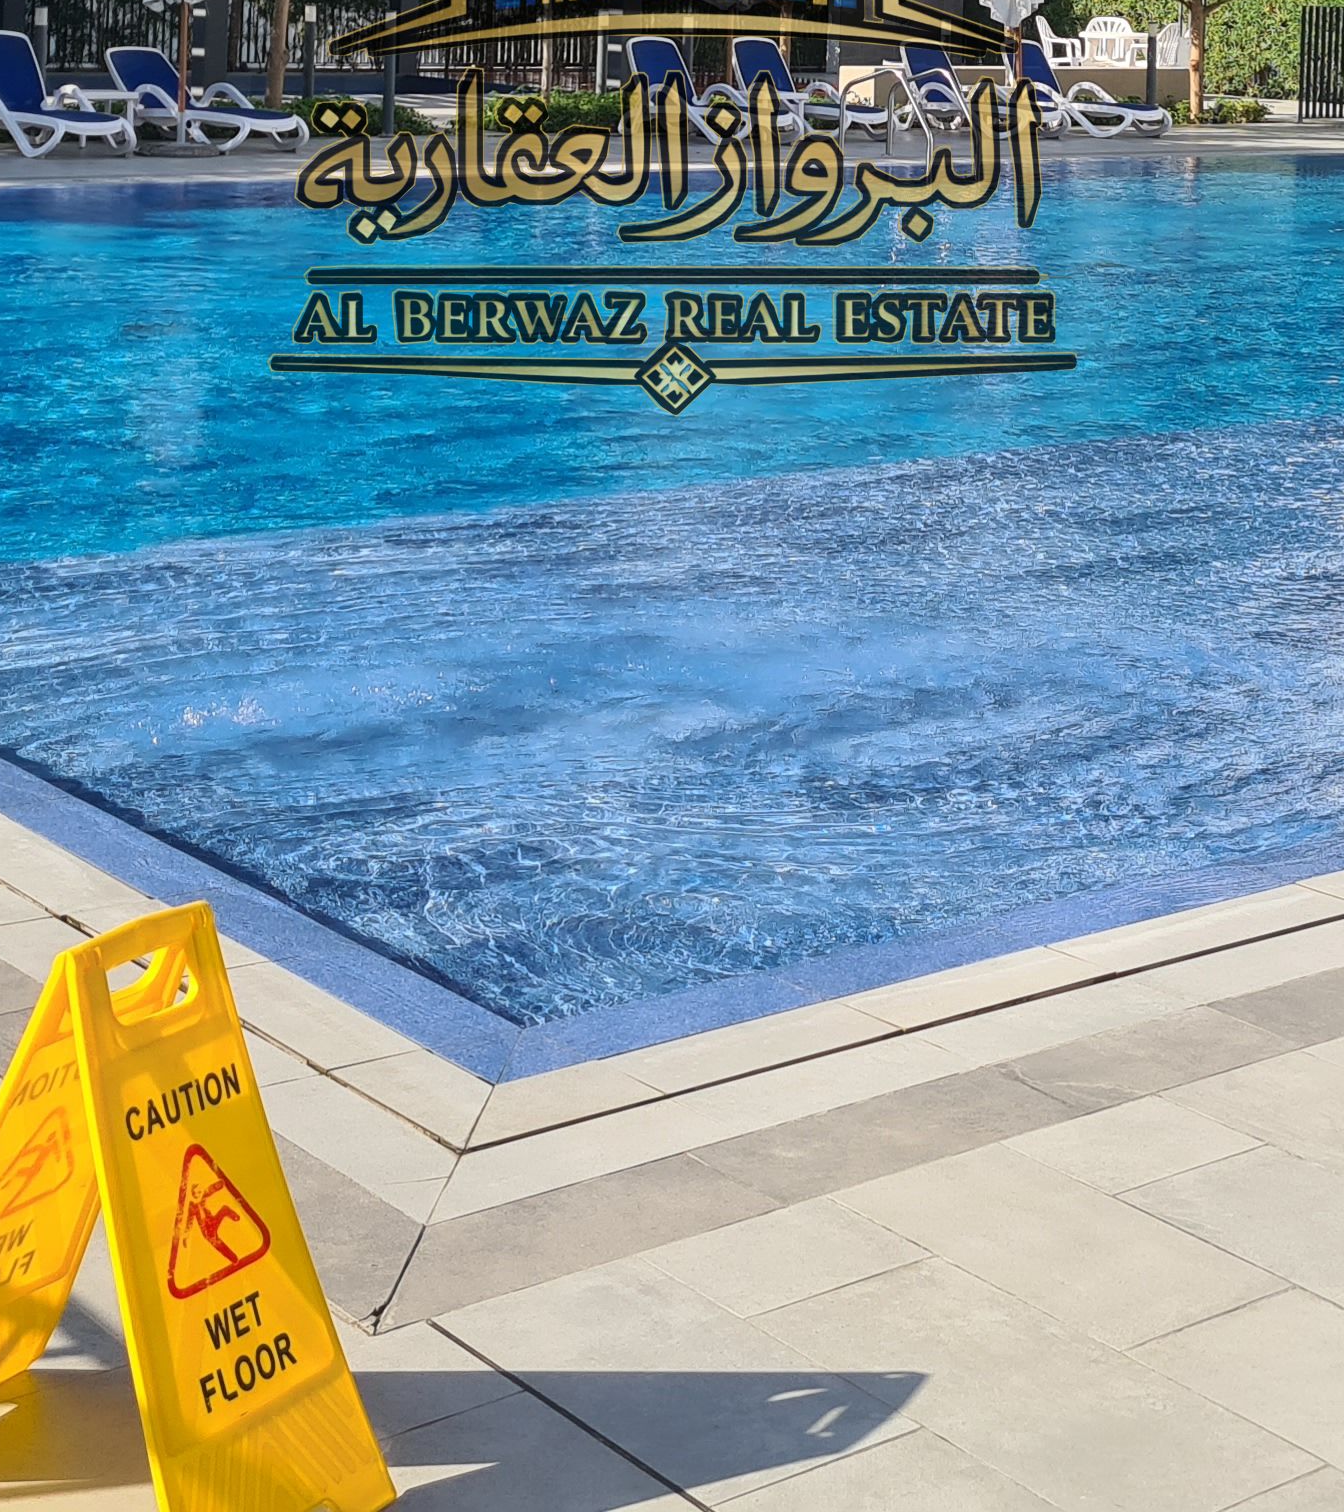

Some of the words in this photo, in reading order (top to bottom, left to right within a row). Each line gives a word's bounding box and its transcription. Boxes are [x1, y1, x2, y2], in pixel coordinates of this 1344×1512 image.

[125, 1063, 241, 1141] CAUTION
[204, 1291, 264, 1351] WET
[199, 1333, 298, 1414] FLOOR
